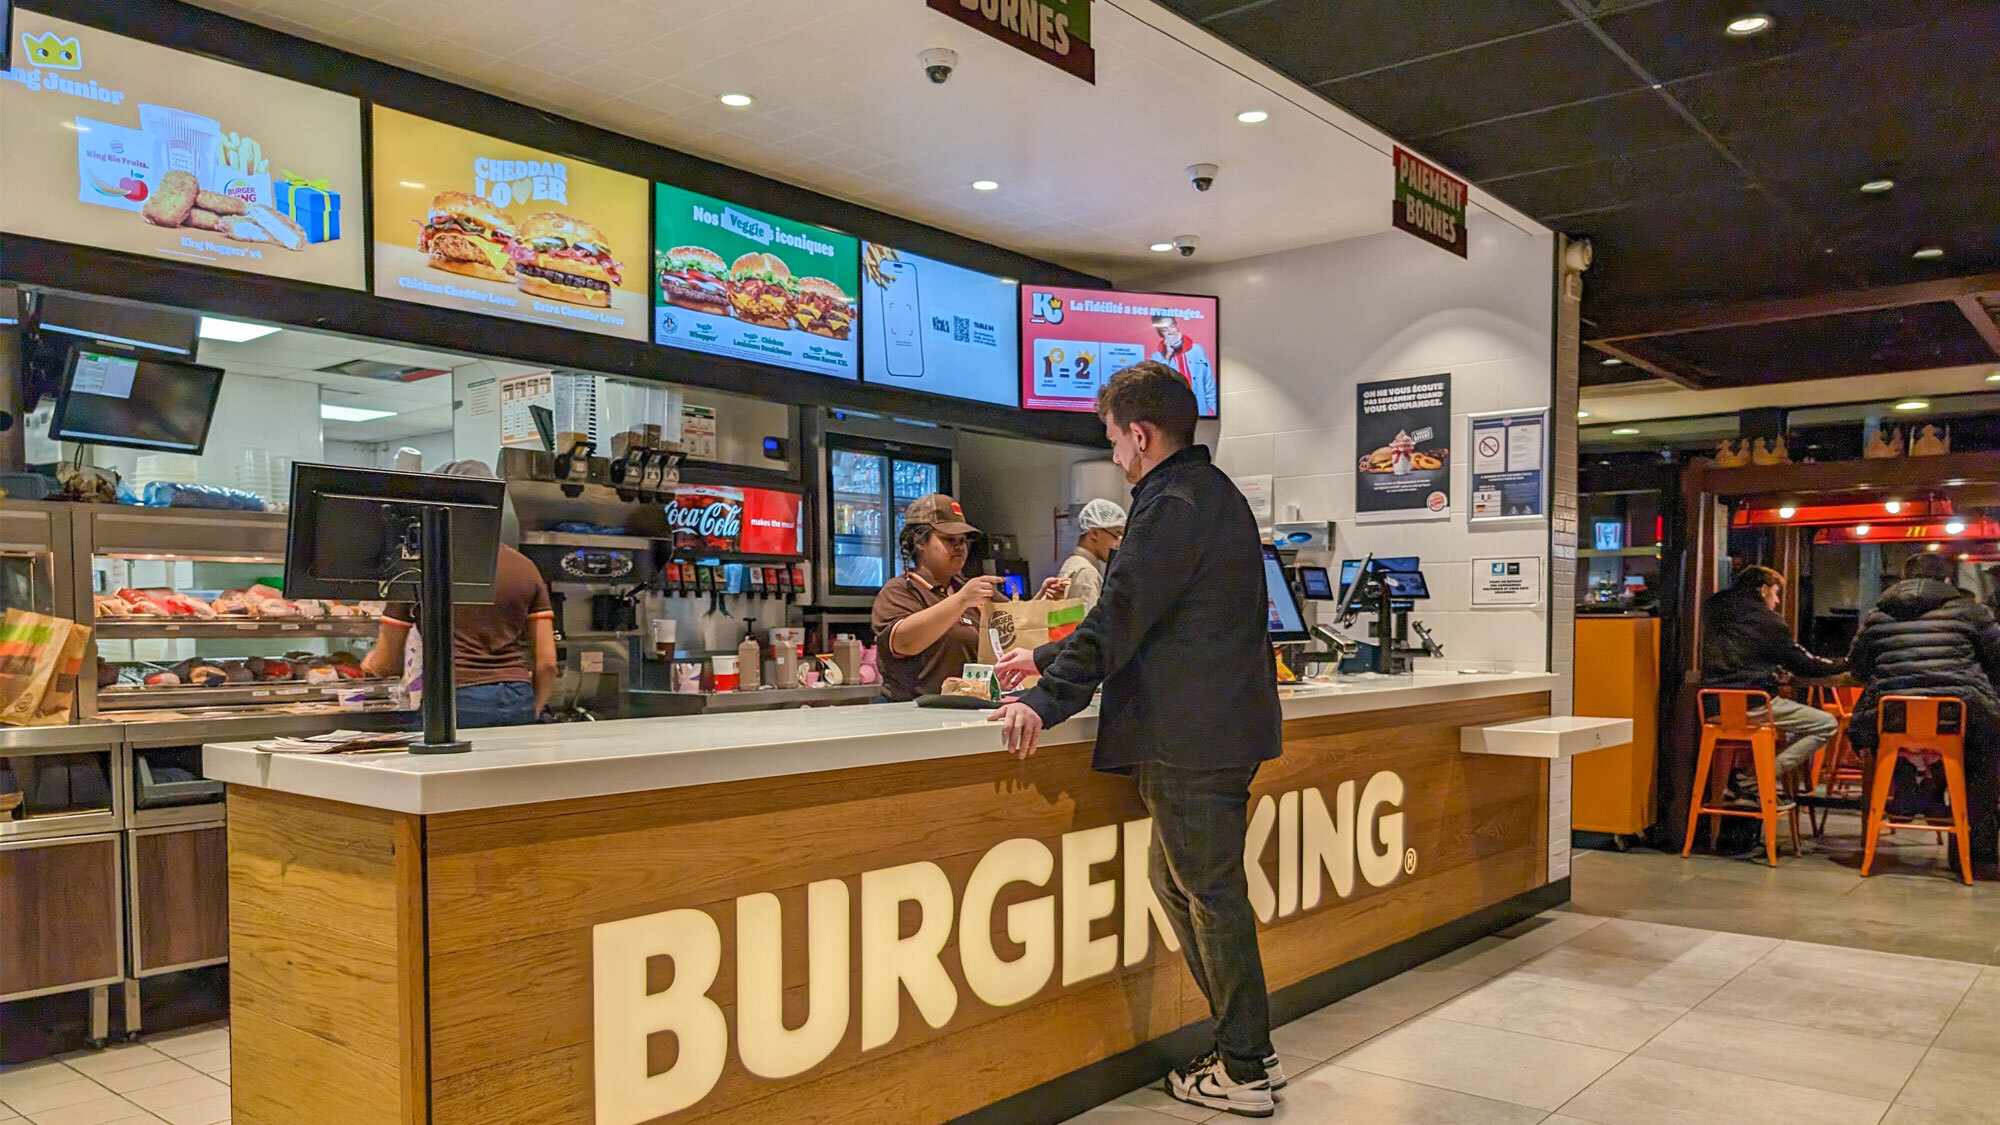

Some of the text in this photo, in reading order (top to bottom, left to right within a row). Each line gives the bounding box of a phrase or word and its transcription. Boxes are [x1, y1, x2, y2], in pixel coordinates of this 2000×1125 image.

[960, 0, 1070, 56] ORNES
[43, 72, 125, 105] Junior
[86, 149, 107, 162] King
[107, 154, 121, 164] Bio
[474, 157, 568, 183] CHEDDAR
[227, 186, 256, 196] BURGER
[1400, 153, 1462, 212] PAIEMENT
[234, 193, 257, 203] NG
[1406, 193, 1456, 244] BORNES
[693, 205, 835, 258] Nos Veggie iconiques
[180, 236, 205, 252] King
[398, 276, 519, 308] Chicken Cheddar Lover
[533, 300, 561, 315] Extra
[1069, 299, 1084, 312] La
[1084, 300, 1123, 315] fidélité
[1124, 304, 1132, 315] a
[1132, 305, 1149, 317] ses
[1074, 355, 1091, 380] 2
[1363, 382, 1444, 399] ON NE VOUS ÉCOUTE
[1363, 391, 1444, 406] PAS SEULEMENT QUAND
[1363, 405, 1387, 414] VOUS
[751, 518, 771, 527] makes
[771, 519, 781, 528] the
[996, 621, 1015, 637] NG
[593, 815, 1181, 1125] BURGER
